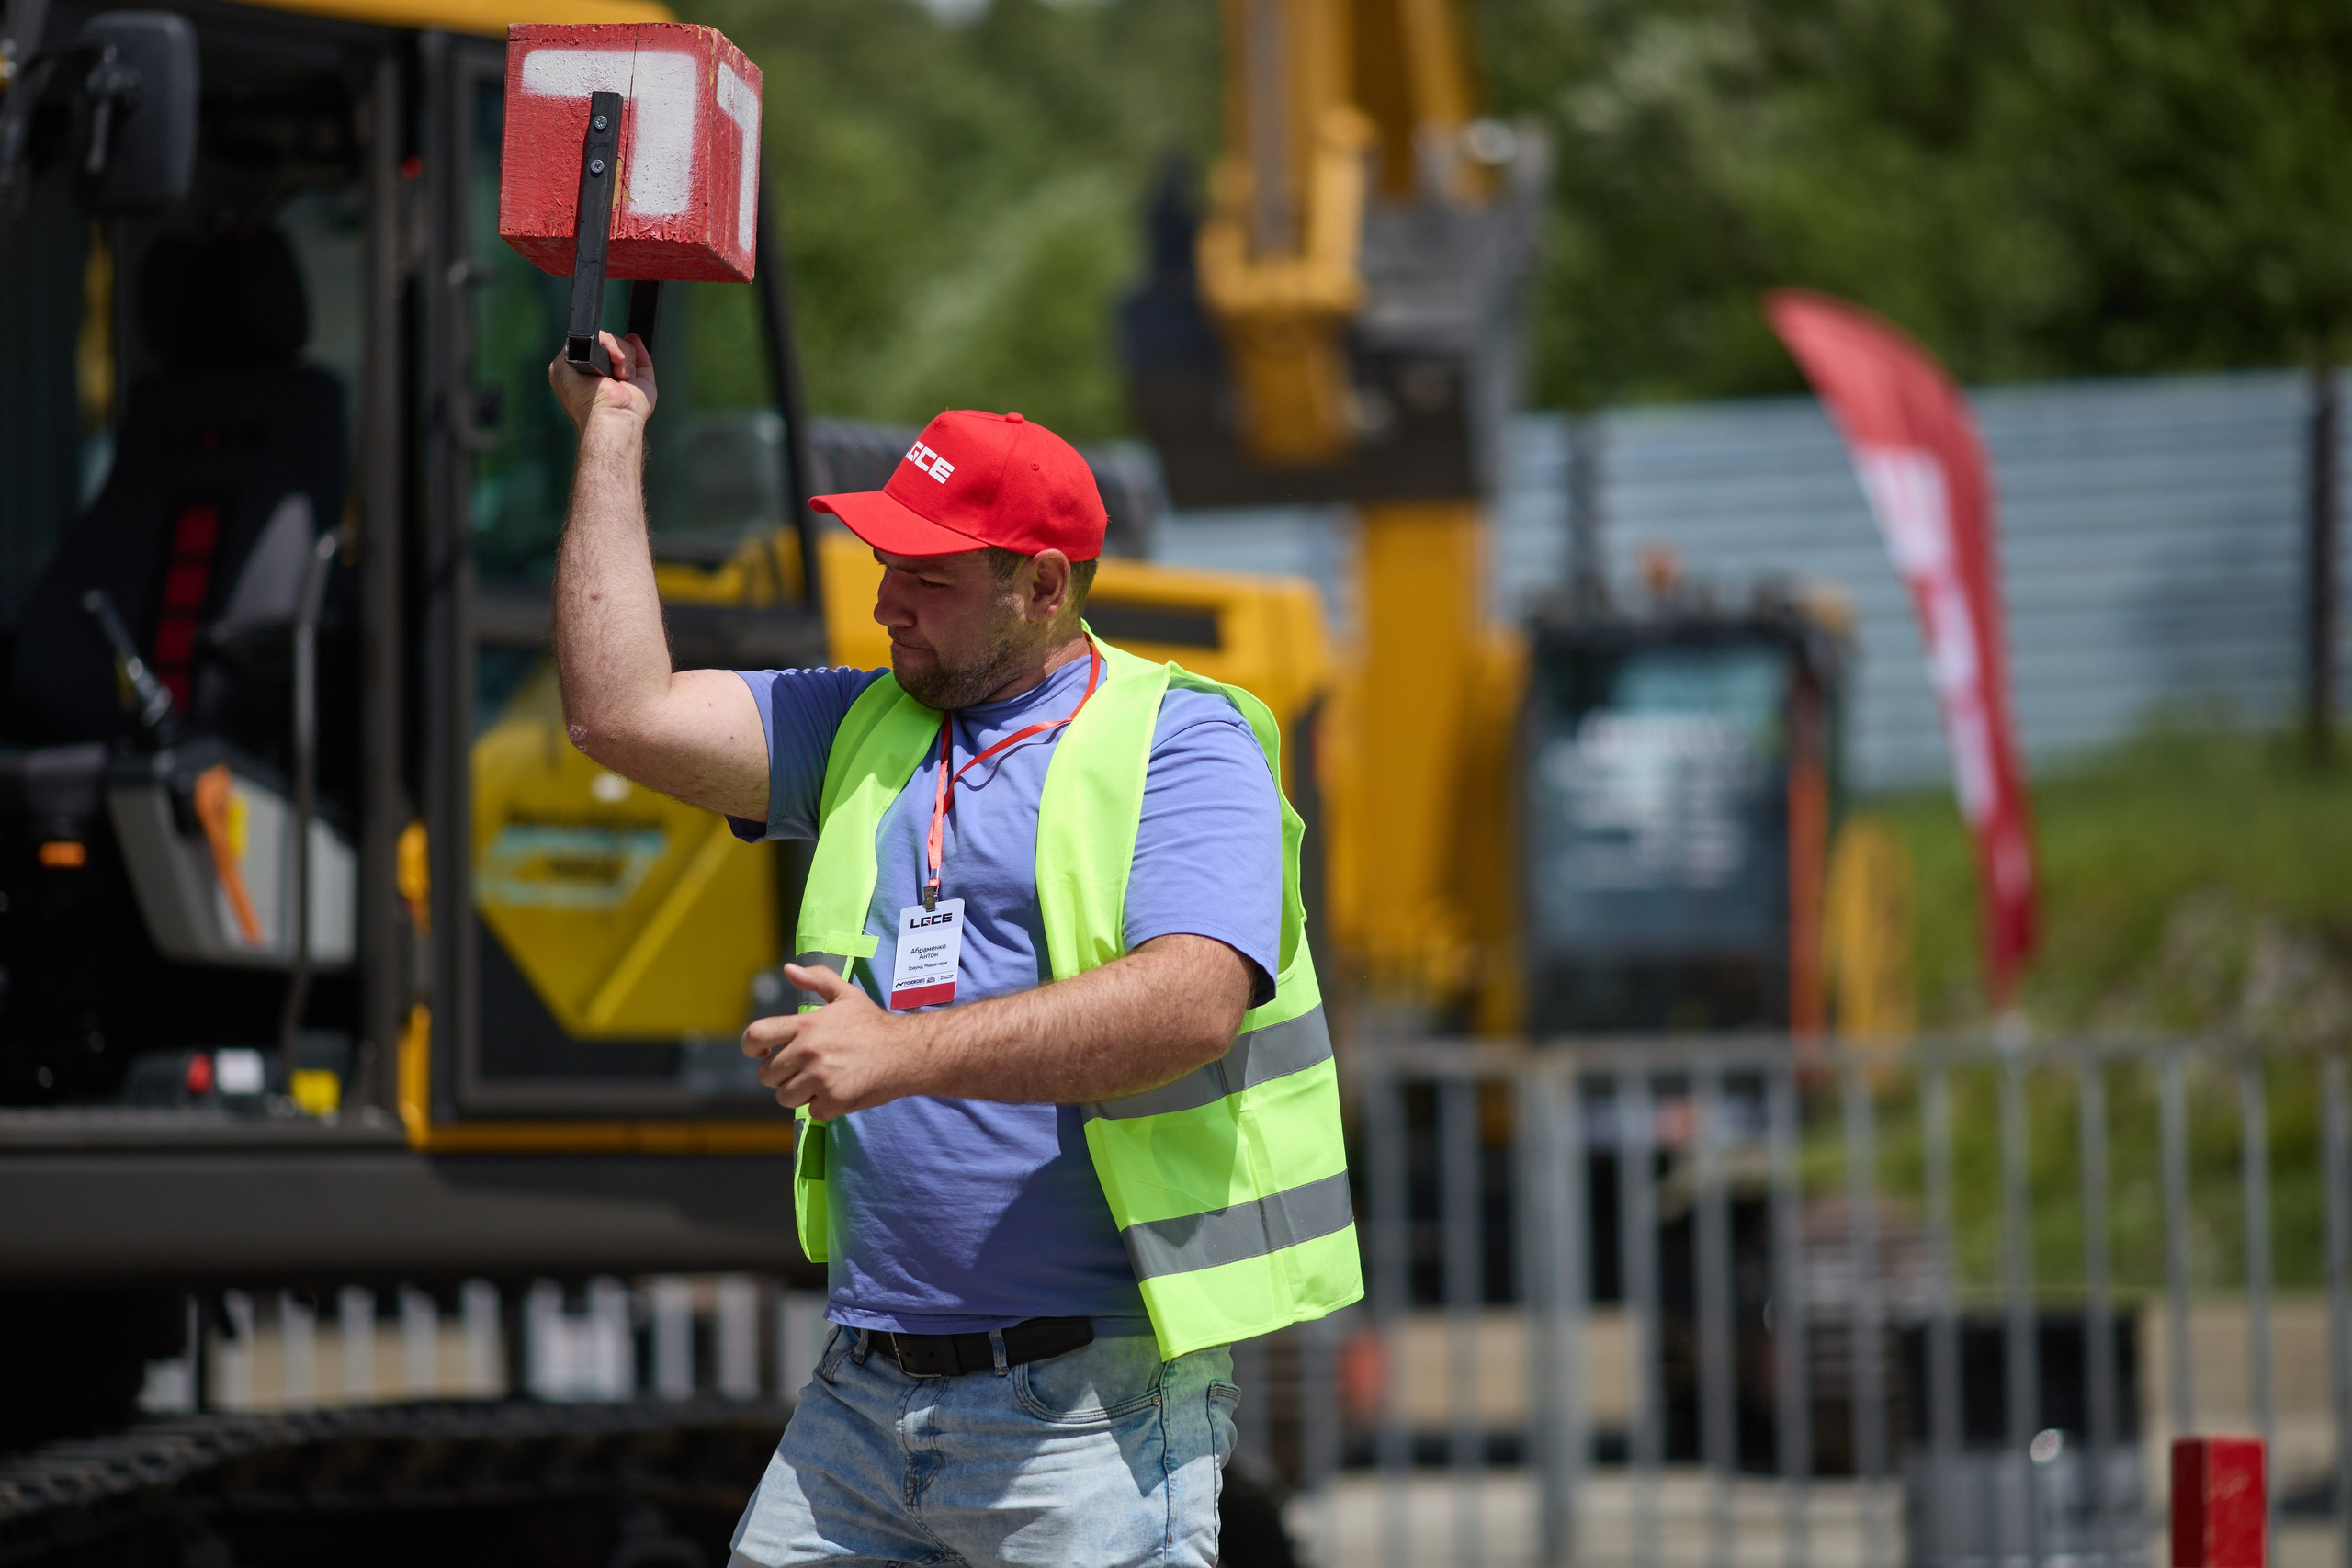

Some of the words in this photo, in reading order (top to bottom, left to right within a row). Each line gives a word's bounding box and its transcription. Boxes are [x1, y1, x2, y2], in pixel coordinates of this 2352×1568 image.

[905, 440, 956, 485] GCE
[910, 912, 953, 929] LGCE
[910, 943, 947, 954] Абраменко
